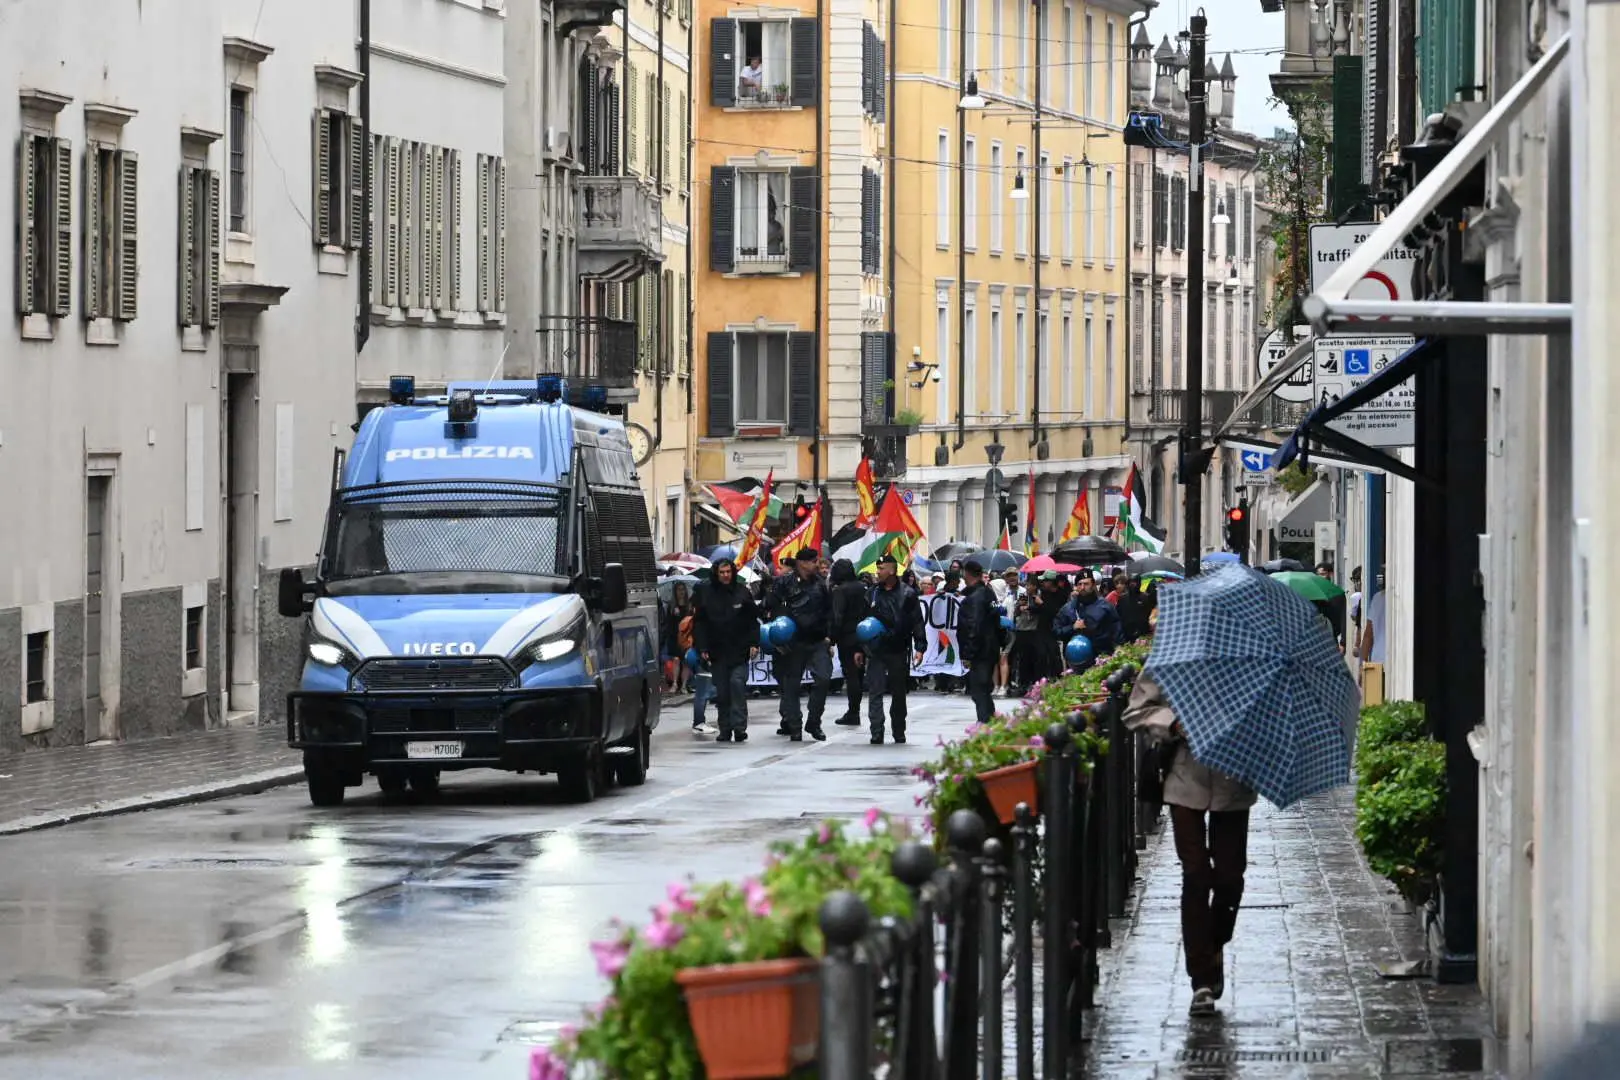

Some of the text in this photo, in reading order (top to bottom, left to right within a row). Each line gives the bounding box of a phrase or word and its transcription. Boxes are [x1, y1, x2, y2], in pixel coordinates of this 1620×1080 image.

[1354, 234, 1370, 243] zo
[1317, 249, 1351, 262] traffi
[385, 446, 534, 462] POLIZIA
[403, 641, 476, 655] IVECO
[434, 744, 460, 755] M7006
